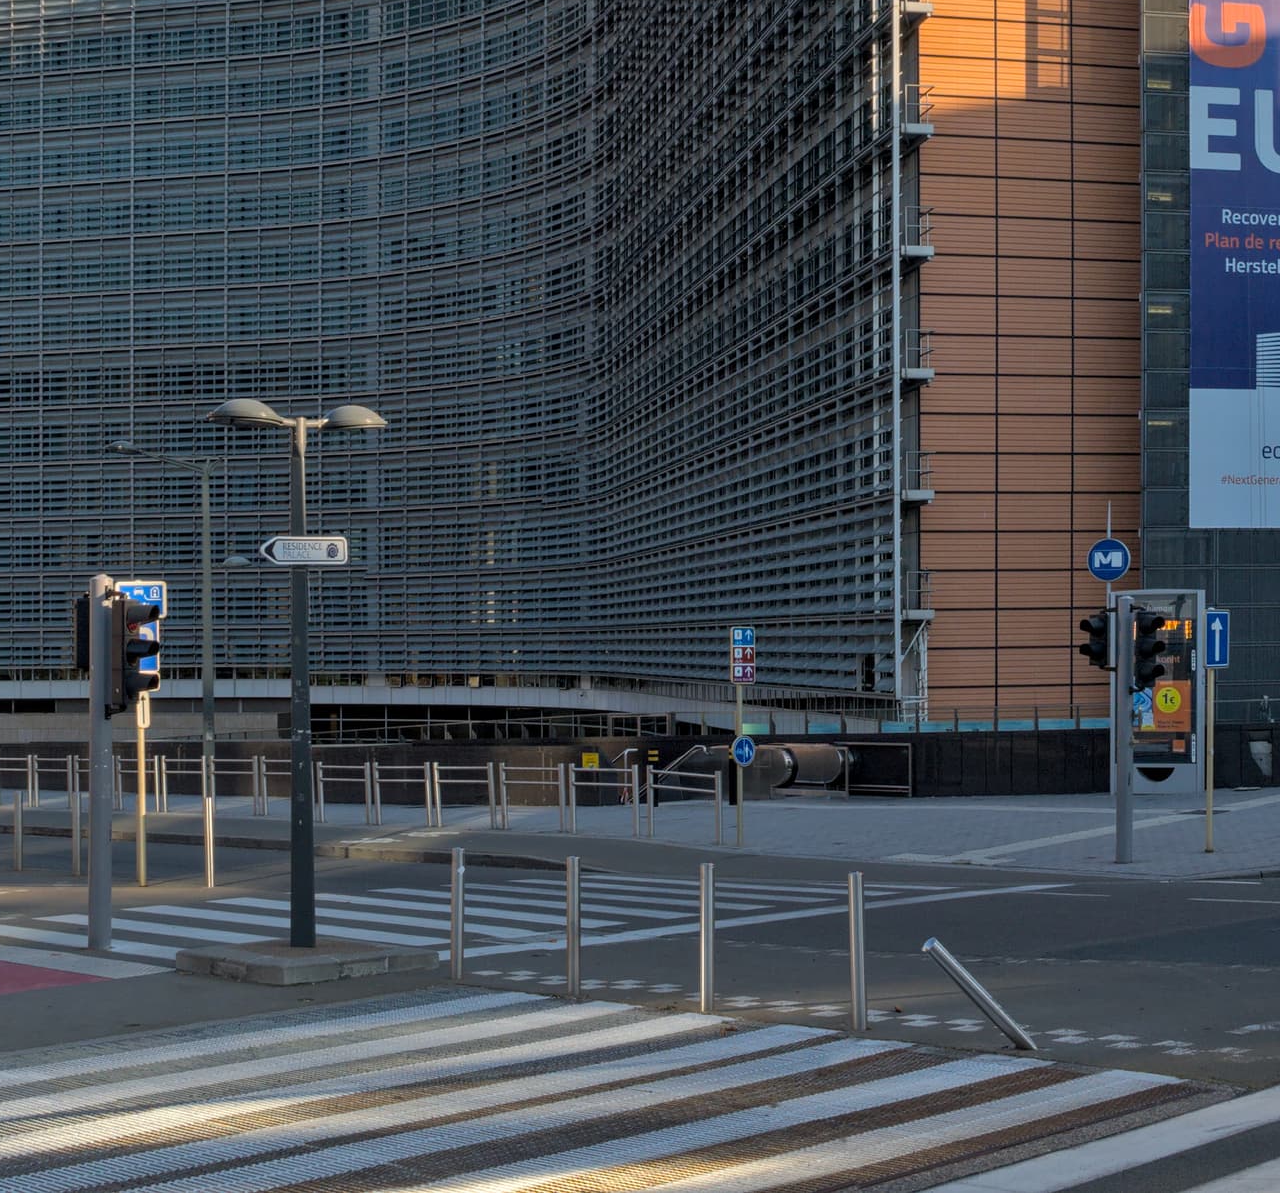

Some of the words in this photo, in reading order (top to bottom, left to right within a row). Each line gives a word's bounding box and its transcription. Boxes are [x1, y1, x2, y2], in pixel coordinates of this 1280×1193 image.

[1205, 232, 1240, 249] Plan
[1245, 233, 1264, 249] de
[282, 542, 323, 551] RESIDENCE
[282, 551, 312, 559] PALACE
